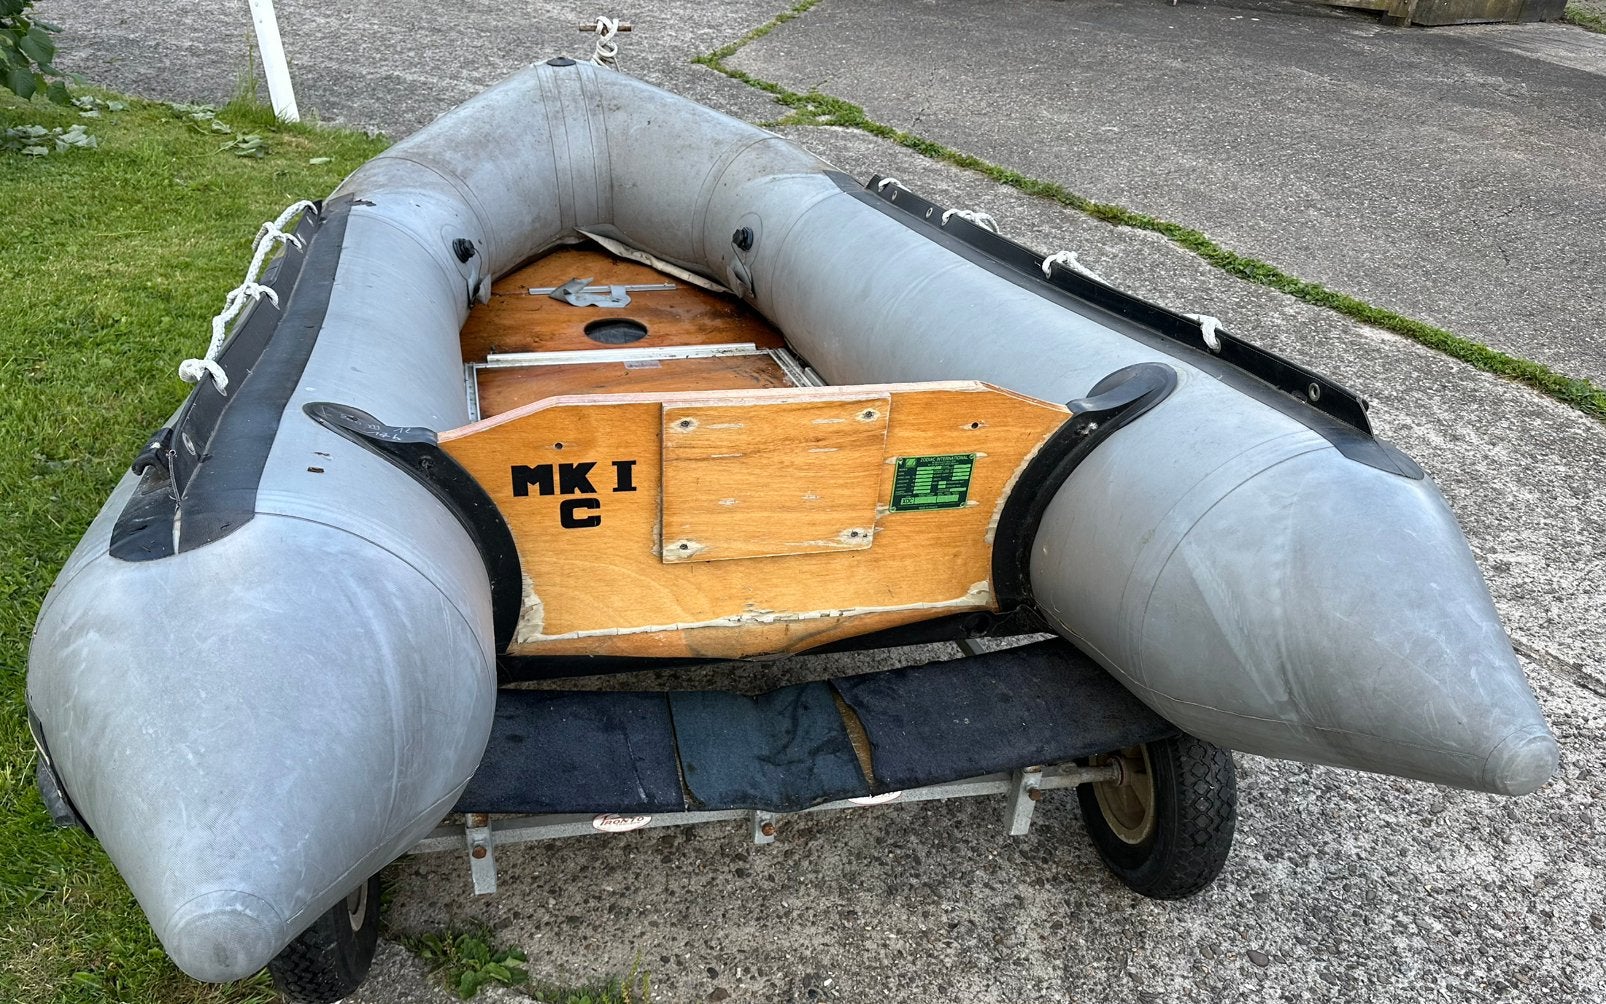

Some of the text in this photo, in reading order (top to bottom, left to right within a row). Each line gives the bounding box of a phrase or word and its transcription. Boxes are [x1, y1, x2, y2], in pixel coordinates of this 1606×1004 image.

[511, 460, 637, 497] MK I
[560, 498, 601, 529] C
